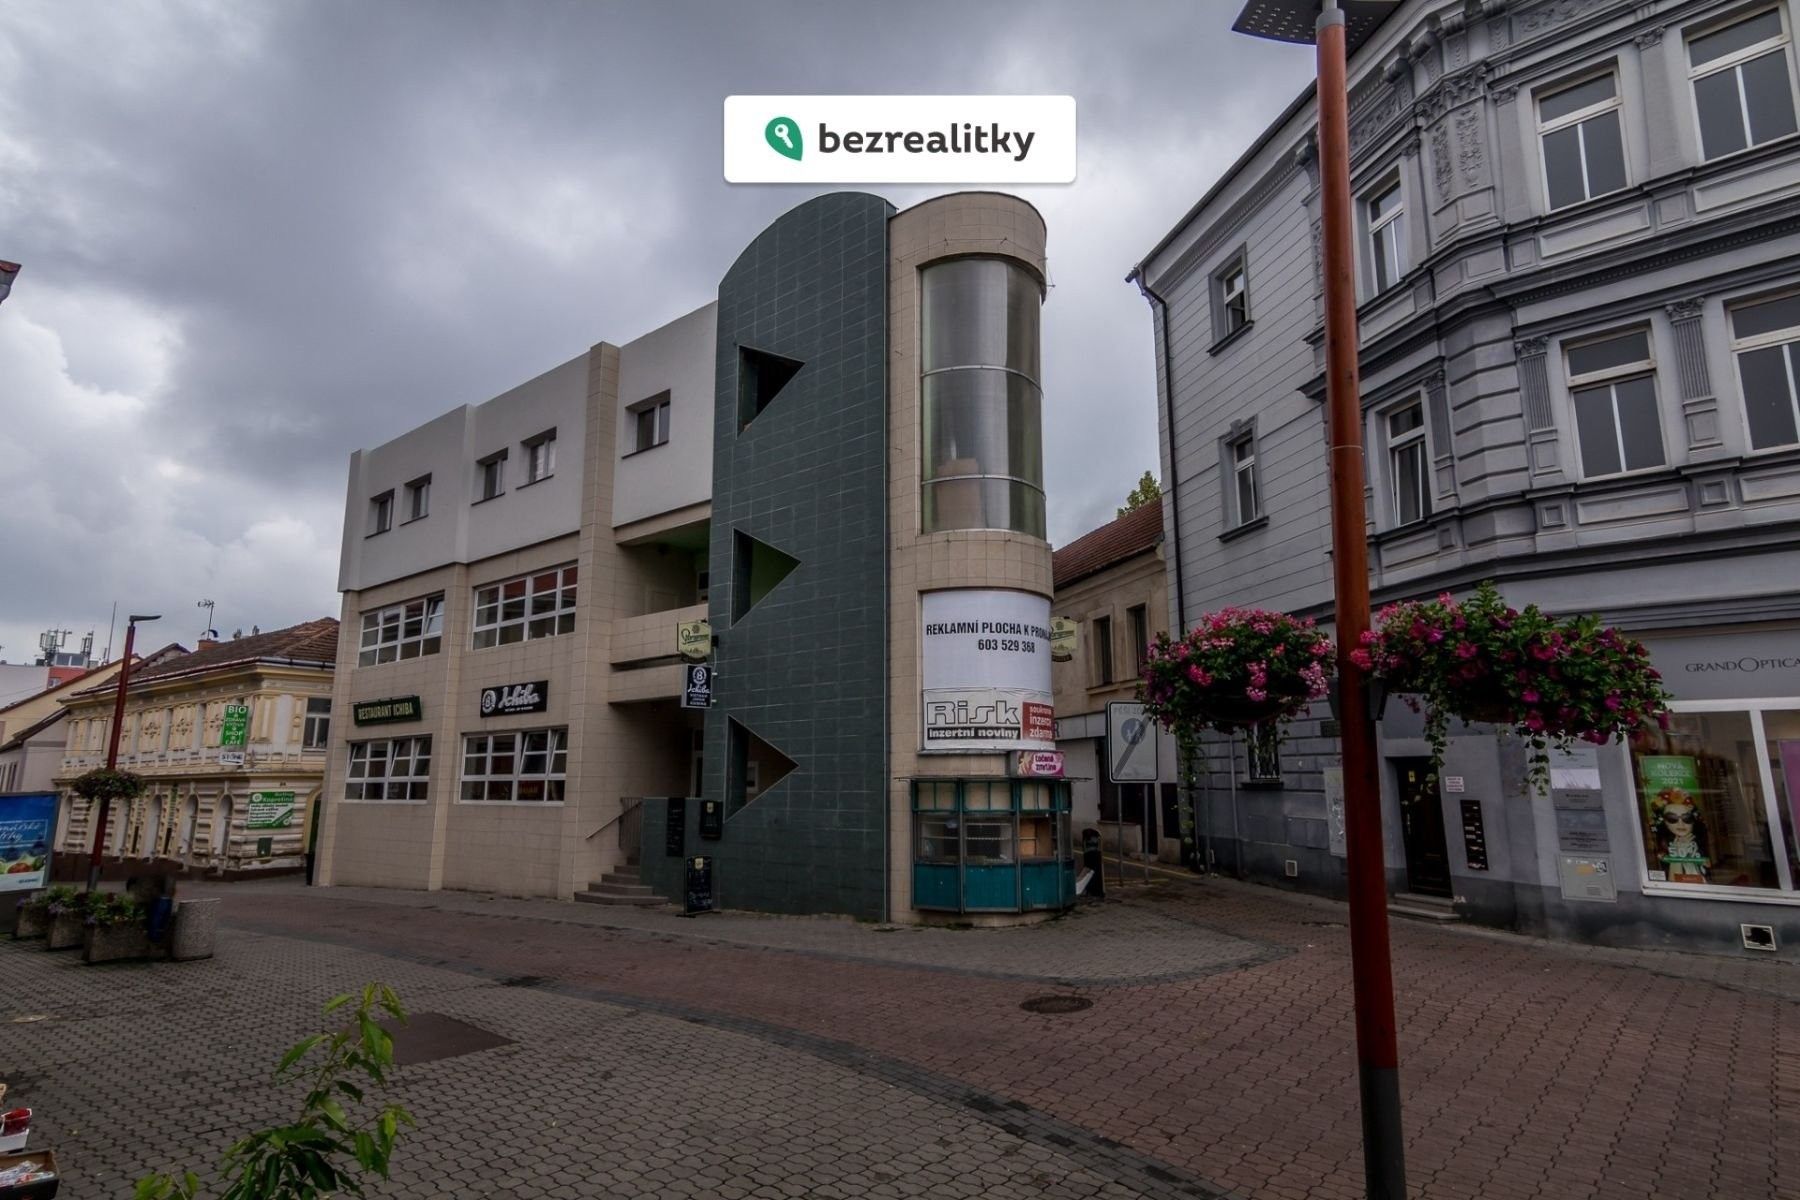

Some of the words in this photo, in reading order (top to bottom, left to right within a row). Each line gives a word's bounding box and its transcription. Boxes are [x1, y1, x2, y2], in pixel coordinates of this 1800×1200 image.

[926, 620, 979, 636] REKLAMNÍ
[981, 622, 1022, 635] PLOCHA
[1023, 624, 1030, 636] K
[978, 639, 999, 651] 603
[1001, 639, 1020, 652] 529
[1021, 640, 1036, 653] 368
[498, 684, 540, 708] Ichiba
[228, 705, 247, 714] BIO
[358, 705, 392, 720] RESTAURANT
[393, 702, 414, 717] ICHIBA
[926, 700, 1020, 726] Risk
[929, 728, 975, 738] inzertní
[978, 728, 1020, 739] noviny
